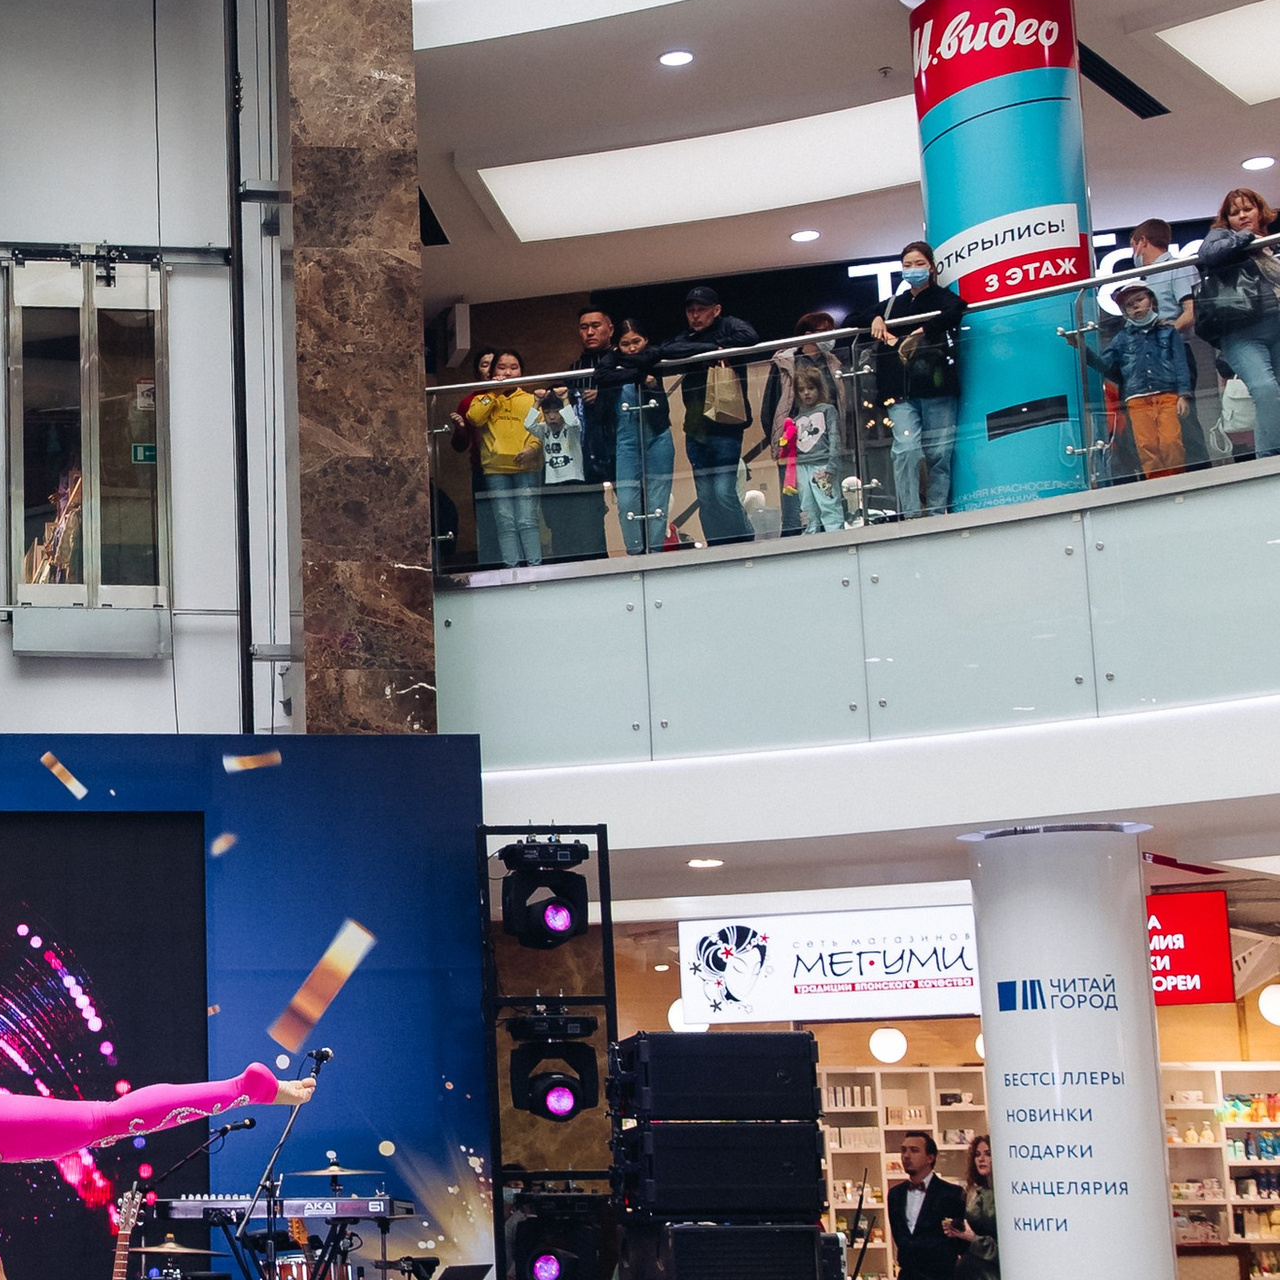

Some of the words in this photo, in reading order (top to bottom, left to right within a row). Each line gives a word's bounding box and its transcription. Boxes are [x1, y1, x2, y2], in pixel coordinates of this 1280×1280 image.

[936, 219, 1066, 276] ОТКРЫЛИСЬ!
[984, 273, 1000, 293] 3
[1005, 257, 1078, 286] ЭТАЖ
[792, 939, 838, 949] сеть
[851, 932, 971, 946] магазинов
[796, 983, 852, 994] традиции
[855, 980, 915, 992] японского
[918, 977, 973, 988] качества
[1049, 974, 1116, 993] ЧИТАЙ
[1051, 993, 1118, 1011] ГОРОД
[1006, 1108, 1093, 1123] НОВИНКИ
[1009, 1145, 1093, 1160] ПОДАРКИ
[1011, 1181, 1129, 1197] КАНЦЕЛЯРИЯ
[304, 1202, 336, 1211] AKAI
[368, 1201, 384, 1212] 61
[1014, 1218, 1068, 1232] КНИГИ
